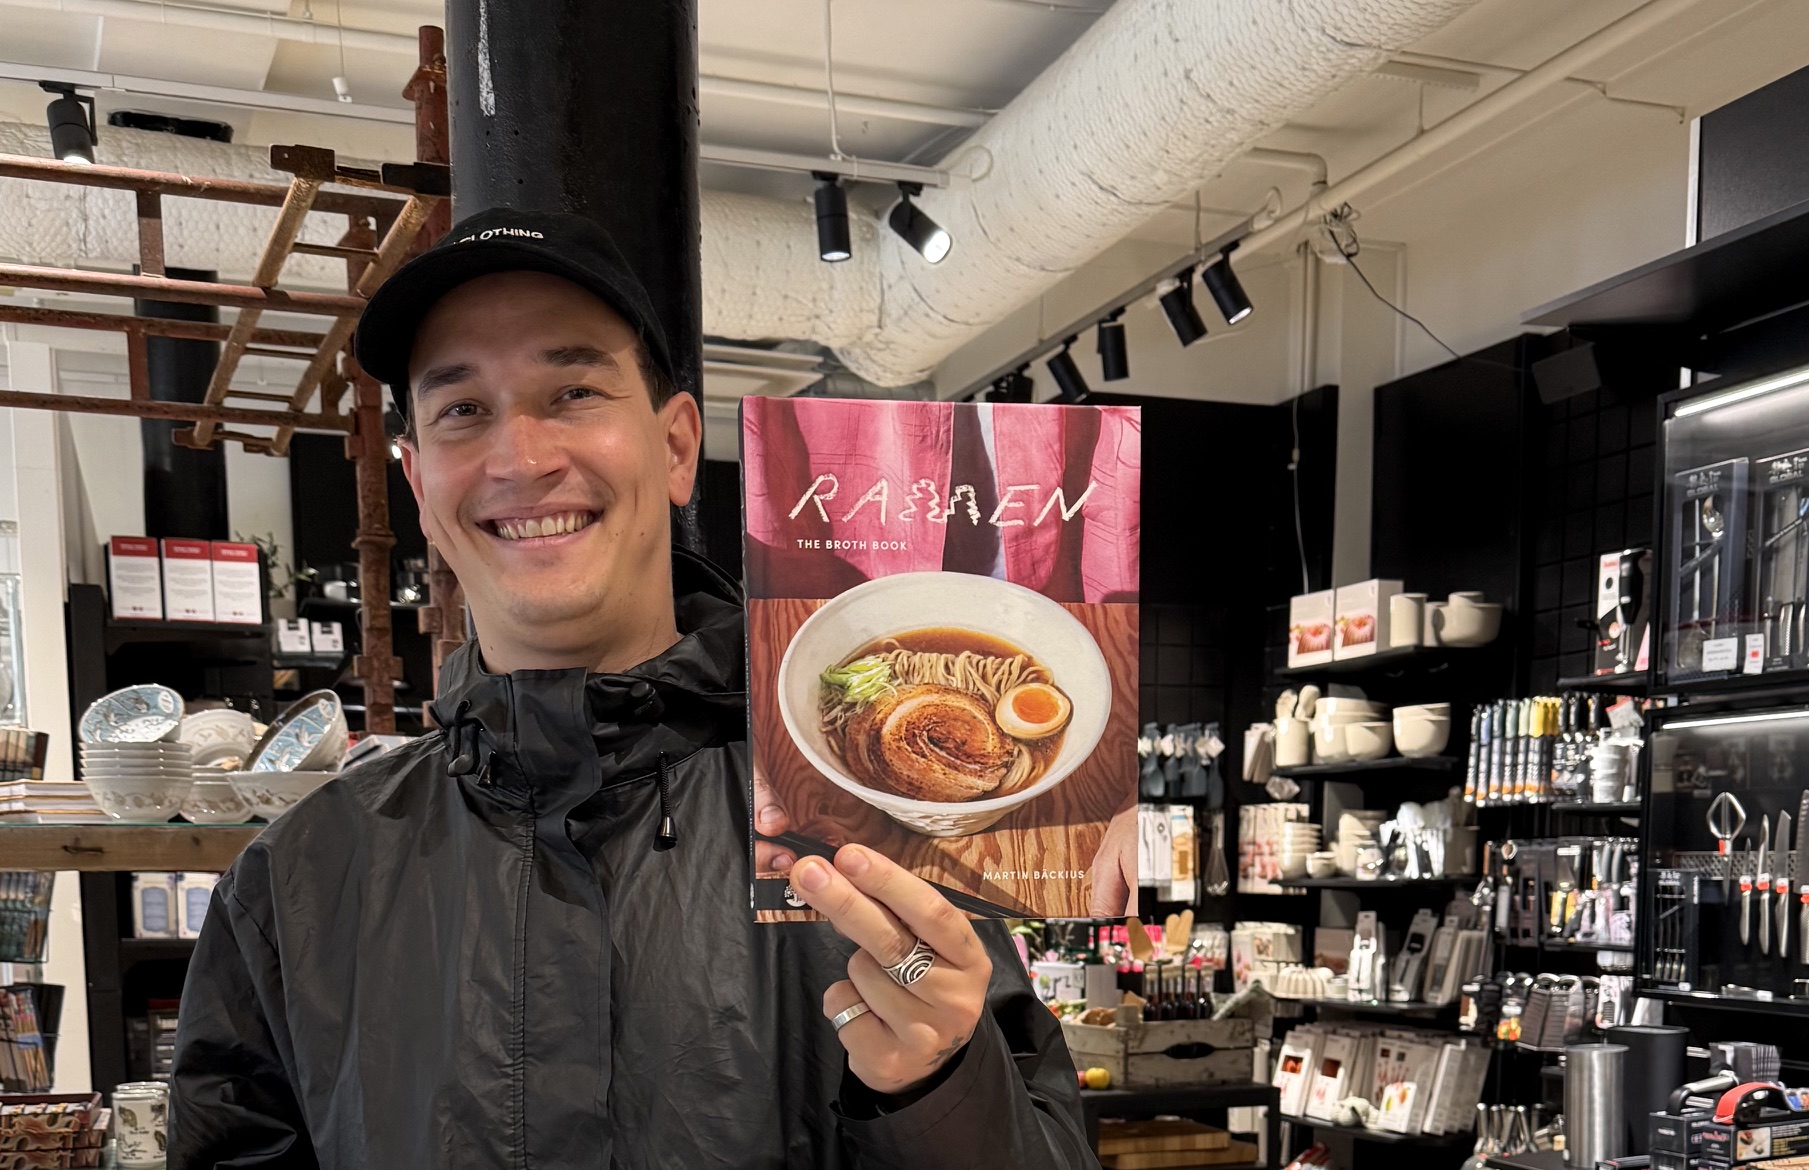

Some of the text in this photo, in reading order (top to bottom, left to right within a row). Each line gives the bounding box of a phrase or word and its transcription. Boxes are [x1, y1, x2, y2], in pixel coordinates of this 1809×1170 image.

[788, 473, 1099, 527] RAMEN
[796, 538, 908, 552] THE BROTH BOOK
[982, 868, 1085, 881] MARTIN BÄCKIUS
